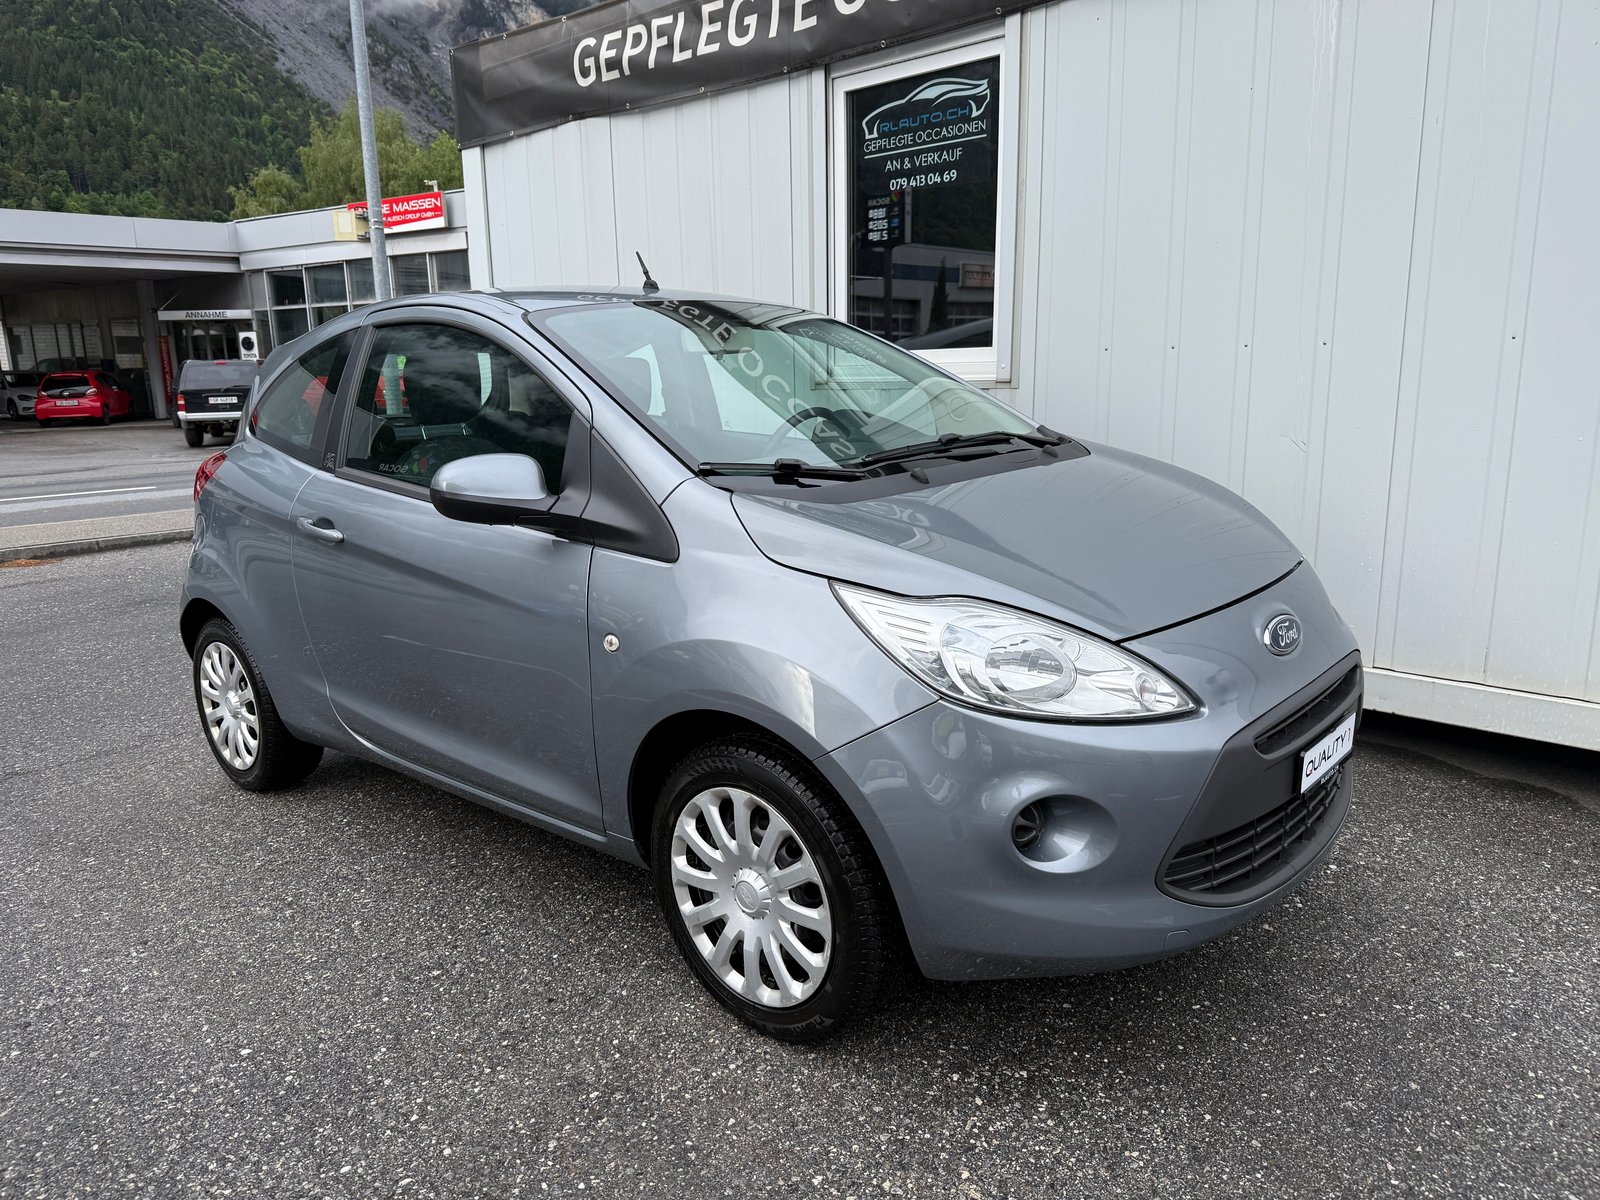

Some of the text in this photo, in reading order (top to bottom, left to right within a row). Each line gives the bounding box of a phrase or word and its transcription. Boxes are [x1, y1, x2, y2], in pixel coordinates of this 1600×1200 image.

[880, 106, 969, 132] RLAUTO.CH
[864, 119, 986, 152] GEPFLEGTE OCCASIONEN
[885, 147, 962, 172] AN & VERKAUF
[889, 169, 957, 191] 079 413 04 69
[393, 197, 440, 213] MAISSEN
[185, 311, 228, 319] ANNAHME
[1277, 621, 1299, 647] Ford
